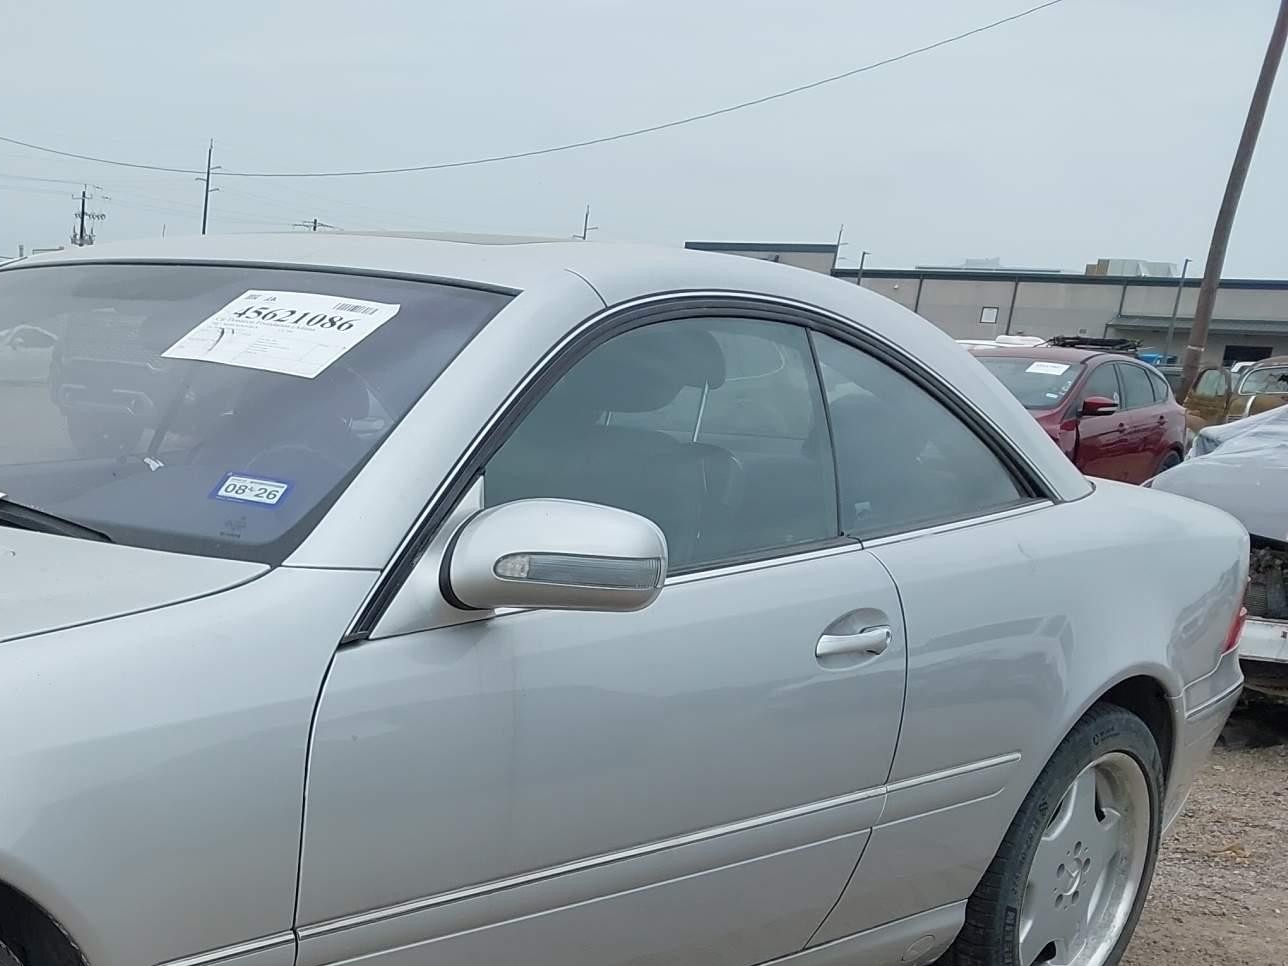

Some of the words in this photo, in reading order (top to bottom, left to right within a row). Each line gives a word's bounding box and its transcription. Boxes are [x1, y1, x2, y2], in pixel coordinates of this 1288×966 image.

[233, 305, 360, 332] 45621086
[224, 483, 248, 495] 08
[254, 488, 280, 500] 26
